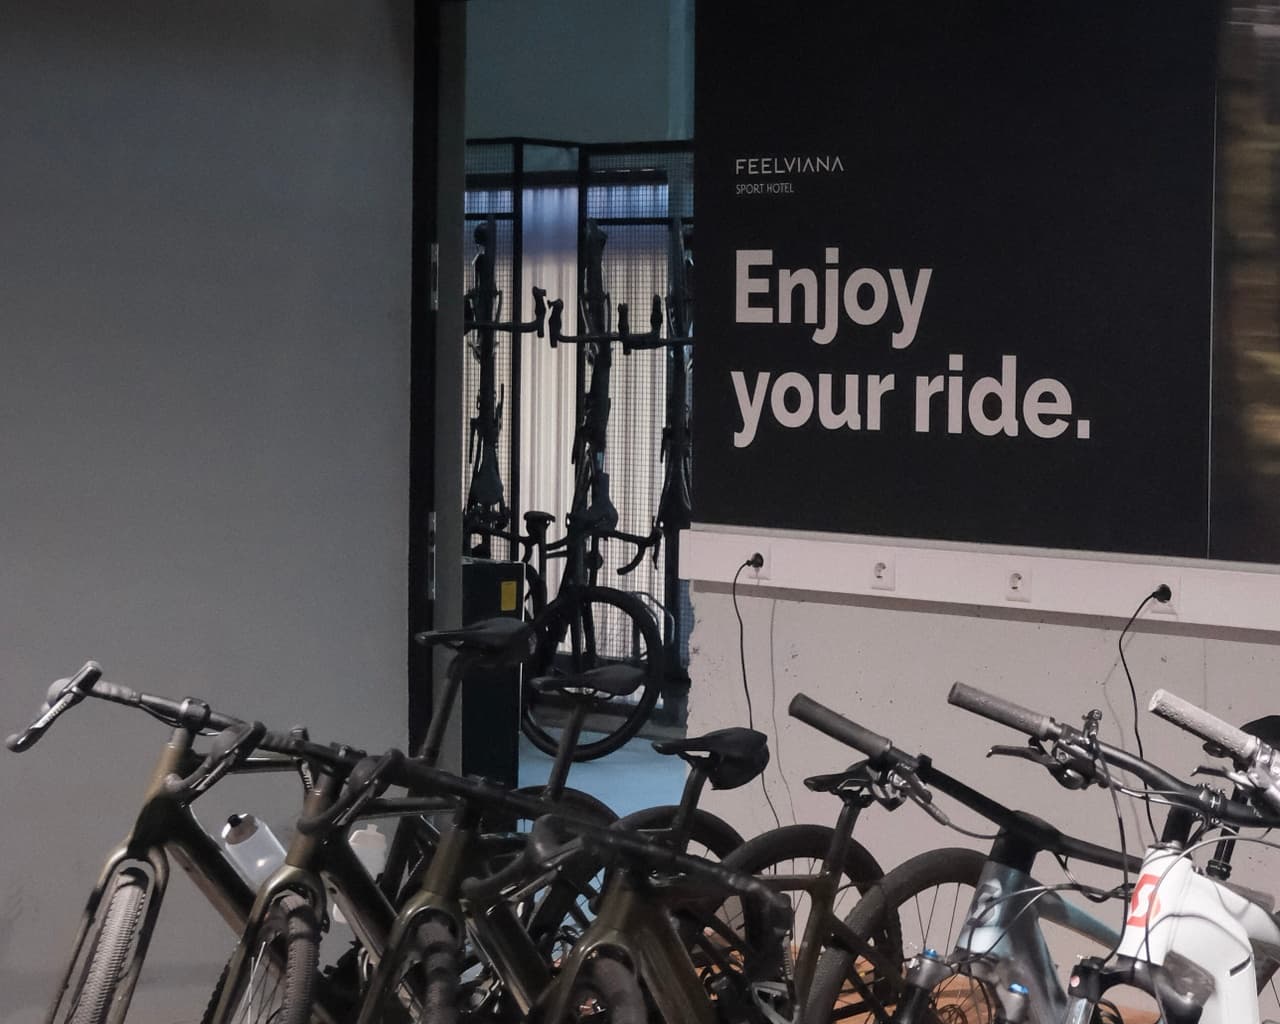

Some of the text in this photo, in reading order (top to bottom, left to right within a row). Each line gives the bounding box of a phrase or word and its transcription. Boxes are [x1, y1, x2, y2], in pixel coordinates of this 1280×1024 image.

[735, 155, 845, 175] FEELVIANA
[735, 182, 795, 195] SPORT HOTEL
[735, 246, 934, 350] Enjoy
[730, 353, 1092, 449] your ride.
